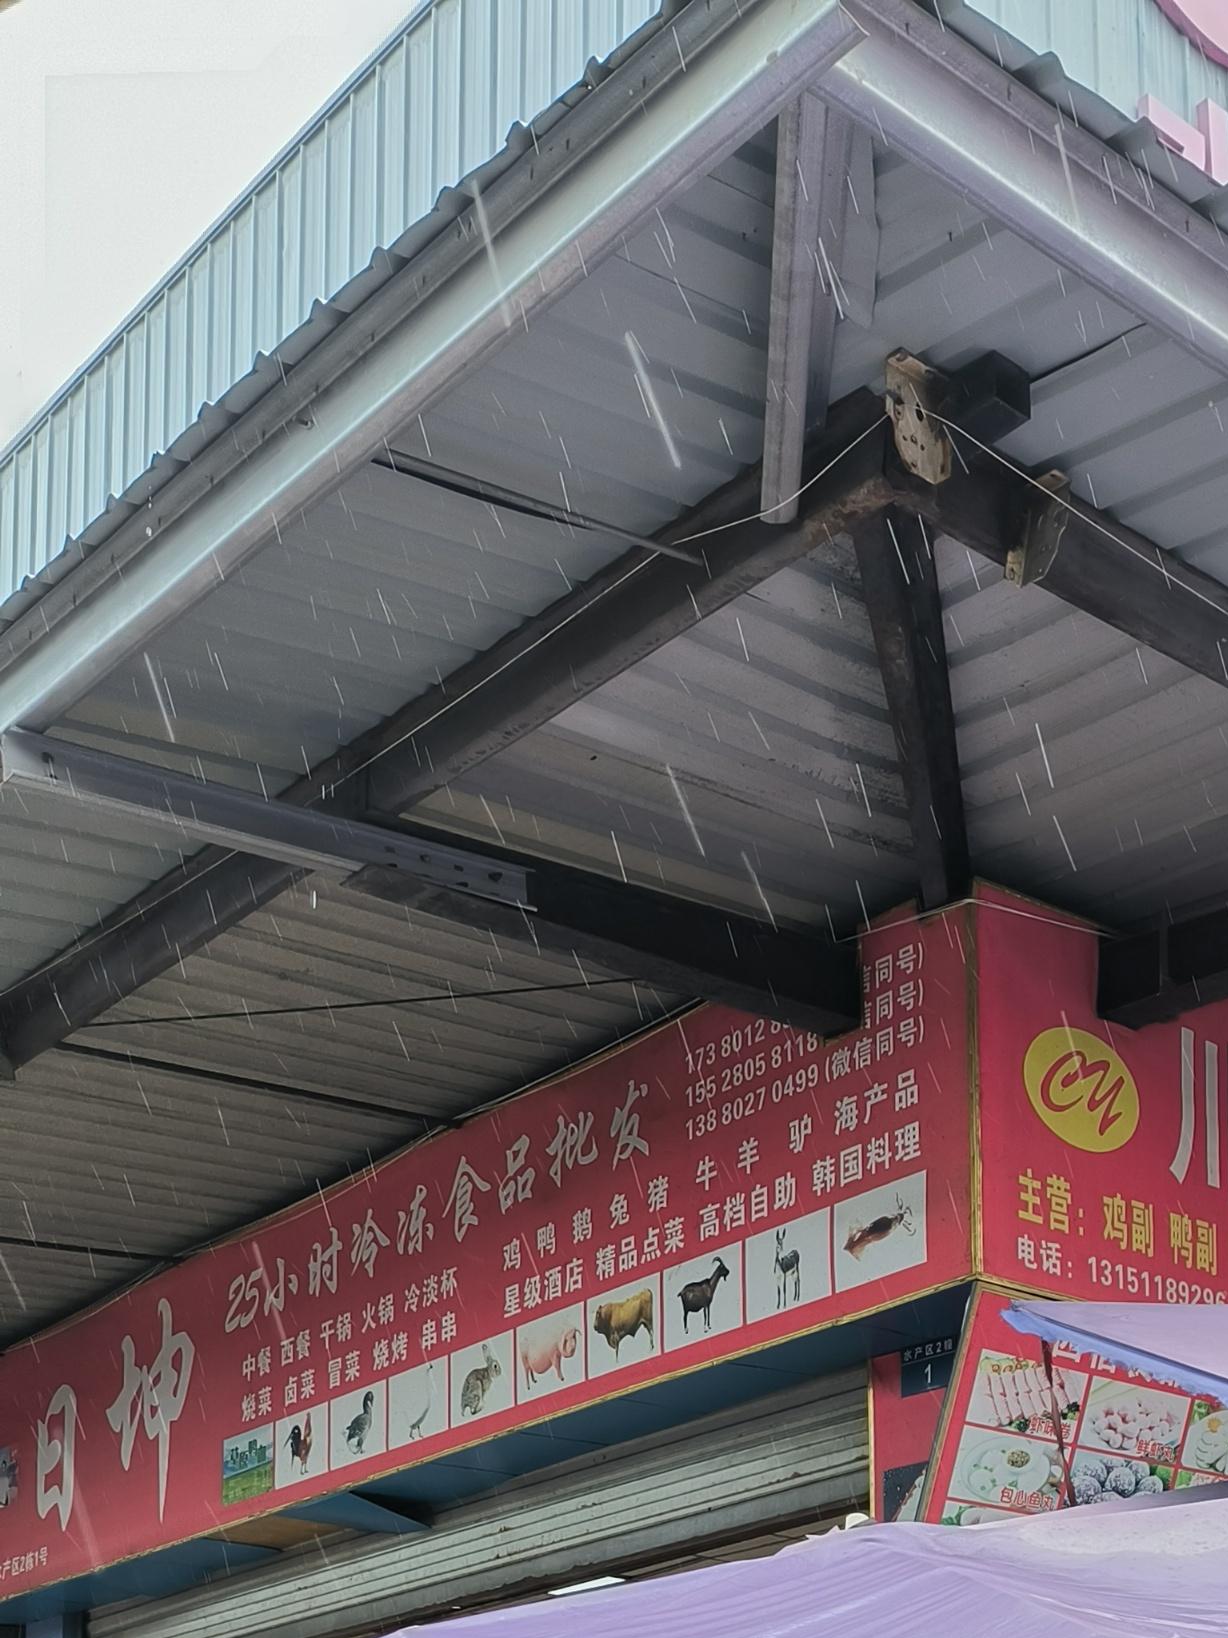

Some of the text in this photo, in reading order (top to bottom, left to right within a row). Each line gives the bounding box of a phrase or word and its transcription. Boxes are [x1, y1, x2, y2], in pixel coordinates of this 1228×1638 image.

[686, 1075, 717, 1107] 155
[722, 1053, 766, 1092] 2805
[686, 1109, 717, 1140] 138
[721, 1086, 766, 1125] 8027
[772, 1064, 819, 1103] 0499
[225, 1079, 650, 1334] 25小时冷冻食品批发
[503, 1238, 521, 1272] 鸡
[537, 1222, 556, 1258] 鸭
[573, 1208, 593, 1244] 鹅
[609, 1193, 630, 1230] 兔
[648, 1175, 669, 1214] 猪
[695, 1155, 716, 1192] 牛
[738, 1137, 760, 1174] 羊
[834, 1068, 920, 1137] 海产品
[503, 1120, 922, 1319] 星级酒店 精品点菜 高档自助 韩国料理
[1102, 1193, 1155, 1258] 鸡副
[1169, 1212, 1218, 1277] 鸭副
[241, 1266, 459, 1382] 中餐 西餐 干锅 火锅 冷淡杯
[241, 1311, 458, 1423] 烧菜 卤菜 冒菜 烧烤 串串
[924, 1363, 932, 1384] 1
[1001, 1486, 1054, 1509] 包心鱼丸
